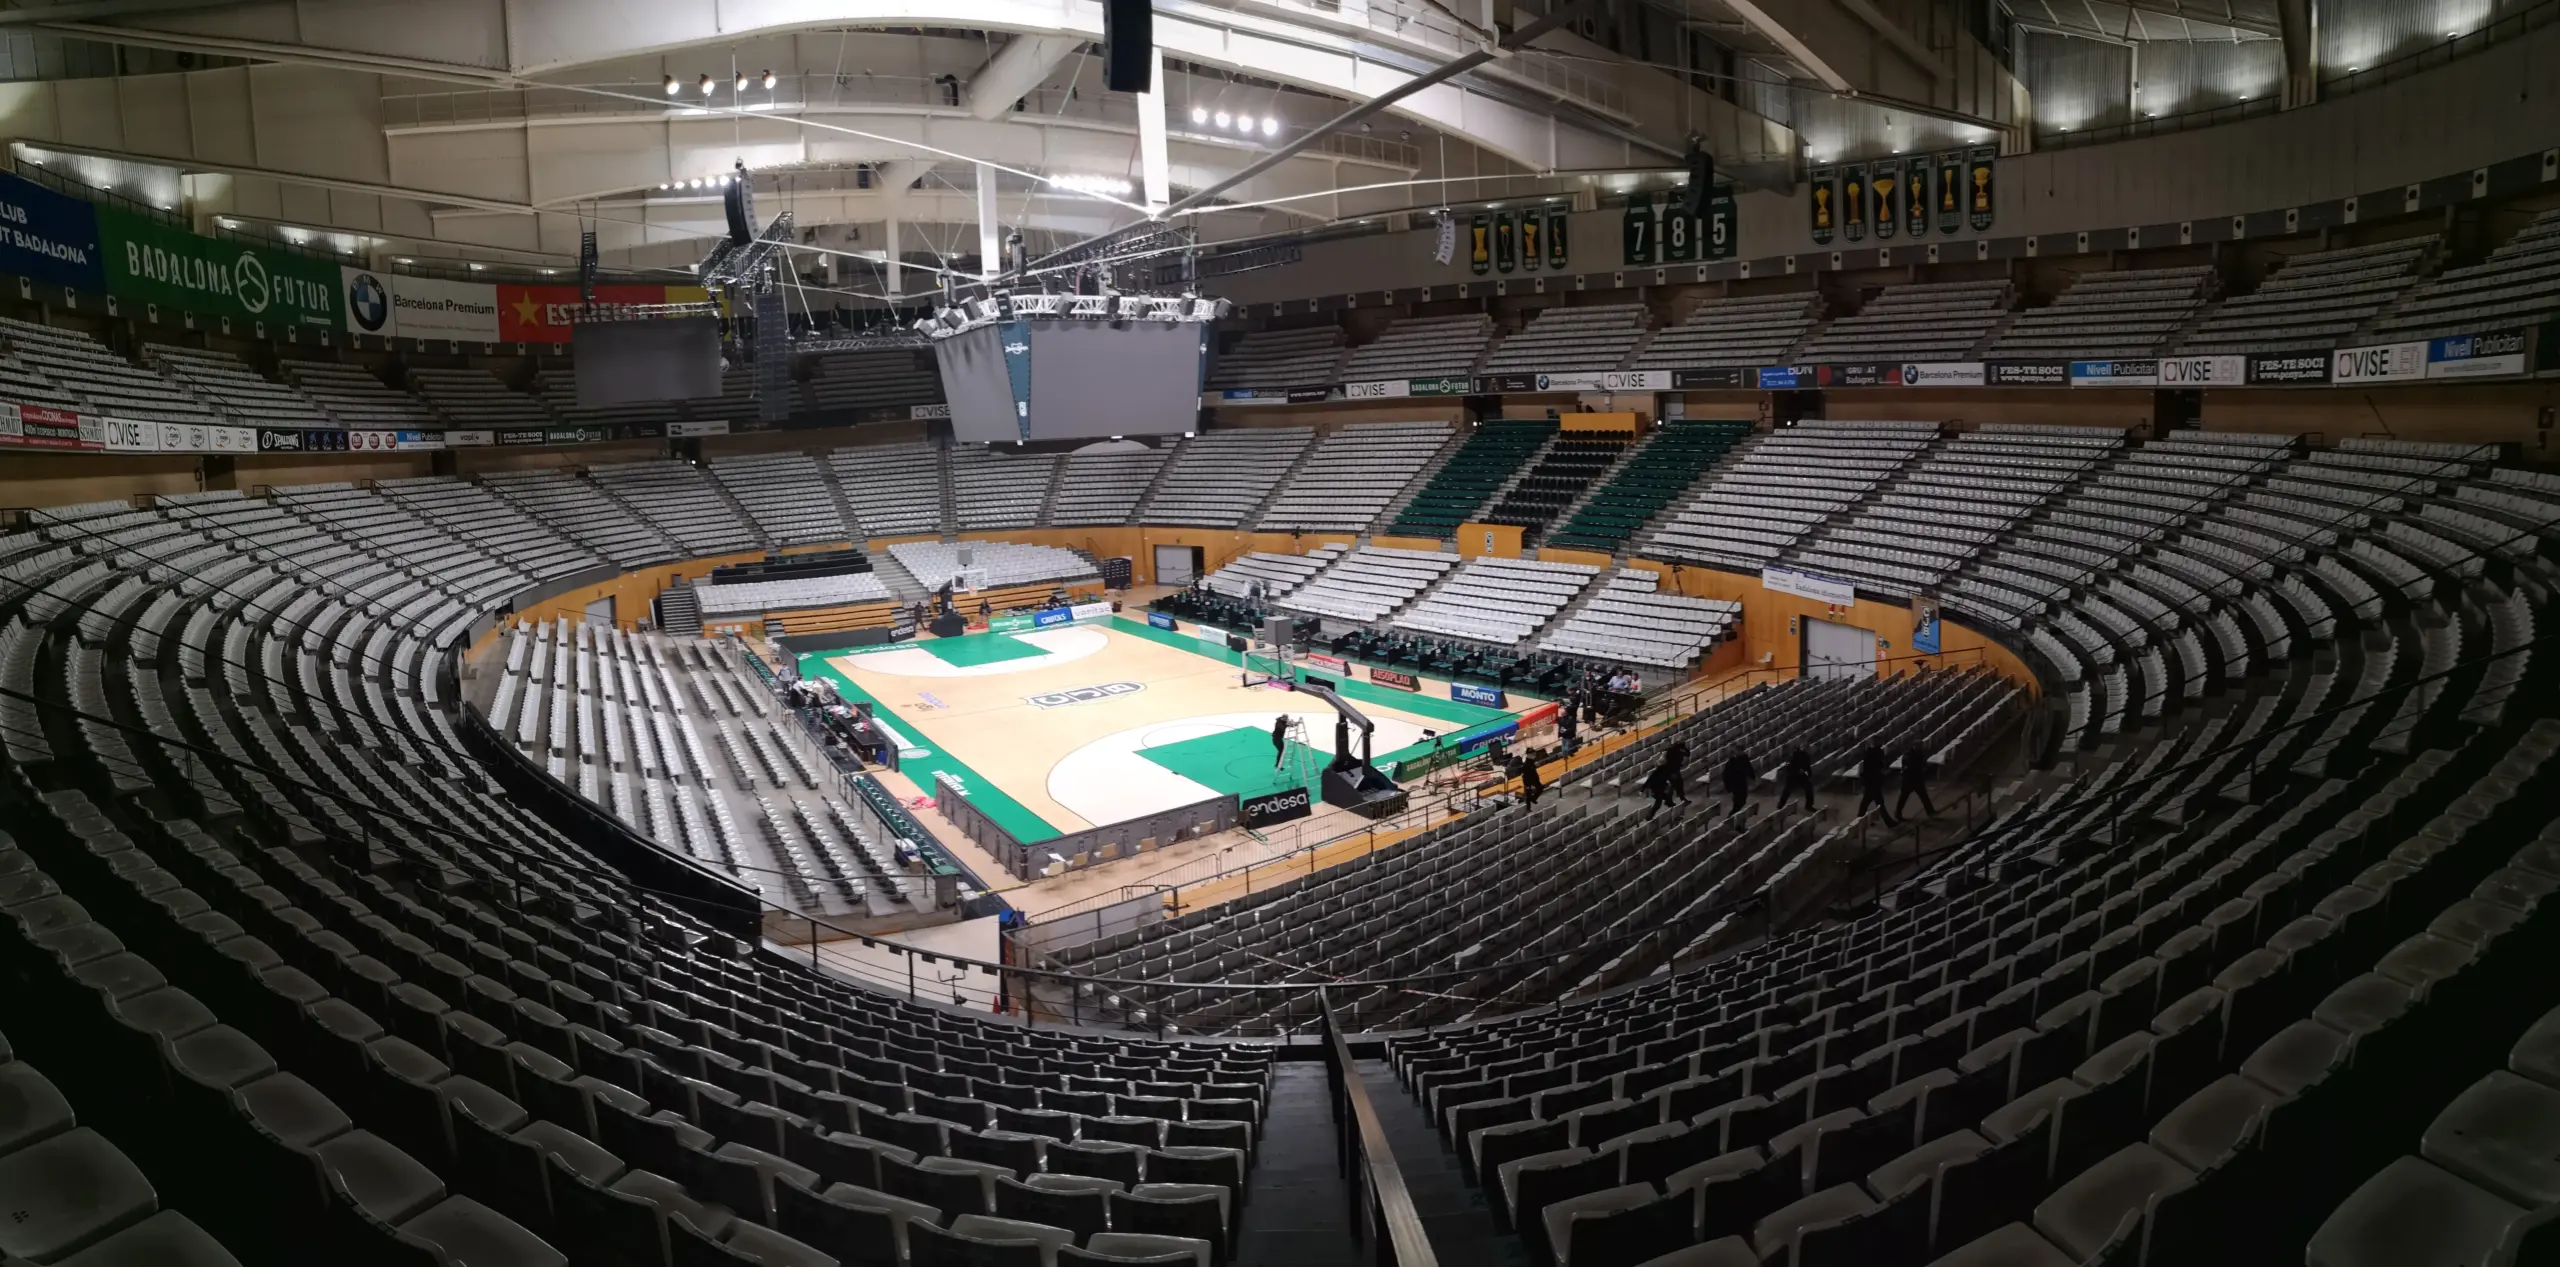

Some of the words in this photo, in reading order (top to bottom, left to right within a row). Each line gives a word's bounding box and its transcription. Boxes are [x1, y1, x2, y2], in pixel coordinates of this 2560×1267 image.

[1633, 221, 1645, 252] 7
[1672, 216, 1685, 247] 8
[1712, 212, 1726, 245] 5
[13, 229, 88, 265] BADALONA
[126, 240, 233, 296] BADALONA
[273, 275, 330, 312] FUTUR
[394, 294, 444, 311] Barcelona
[445, 299, 495, 315] Premium
[1920, 368, 1952, 379] Barcelona
[1953, 368, 1983, 379] Premium
[2000, 366, 2037, 375] FES-TE
[2038, 366, 2063, 375] SOCI
[2086, 363, 2111, 375] Nivell
[2113, 361, 2156, 376] Publicitari
[2259, 359, 2296, 370] FES-TE
[2297, 357, 2325, 369] SOCI
[274, 433, 299, 447] SPALDING
[550, 432, 576, 440] BADALONA
[1248, 793, 1308, 817] endesa
